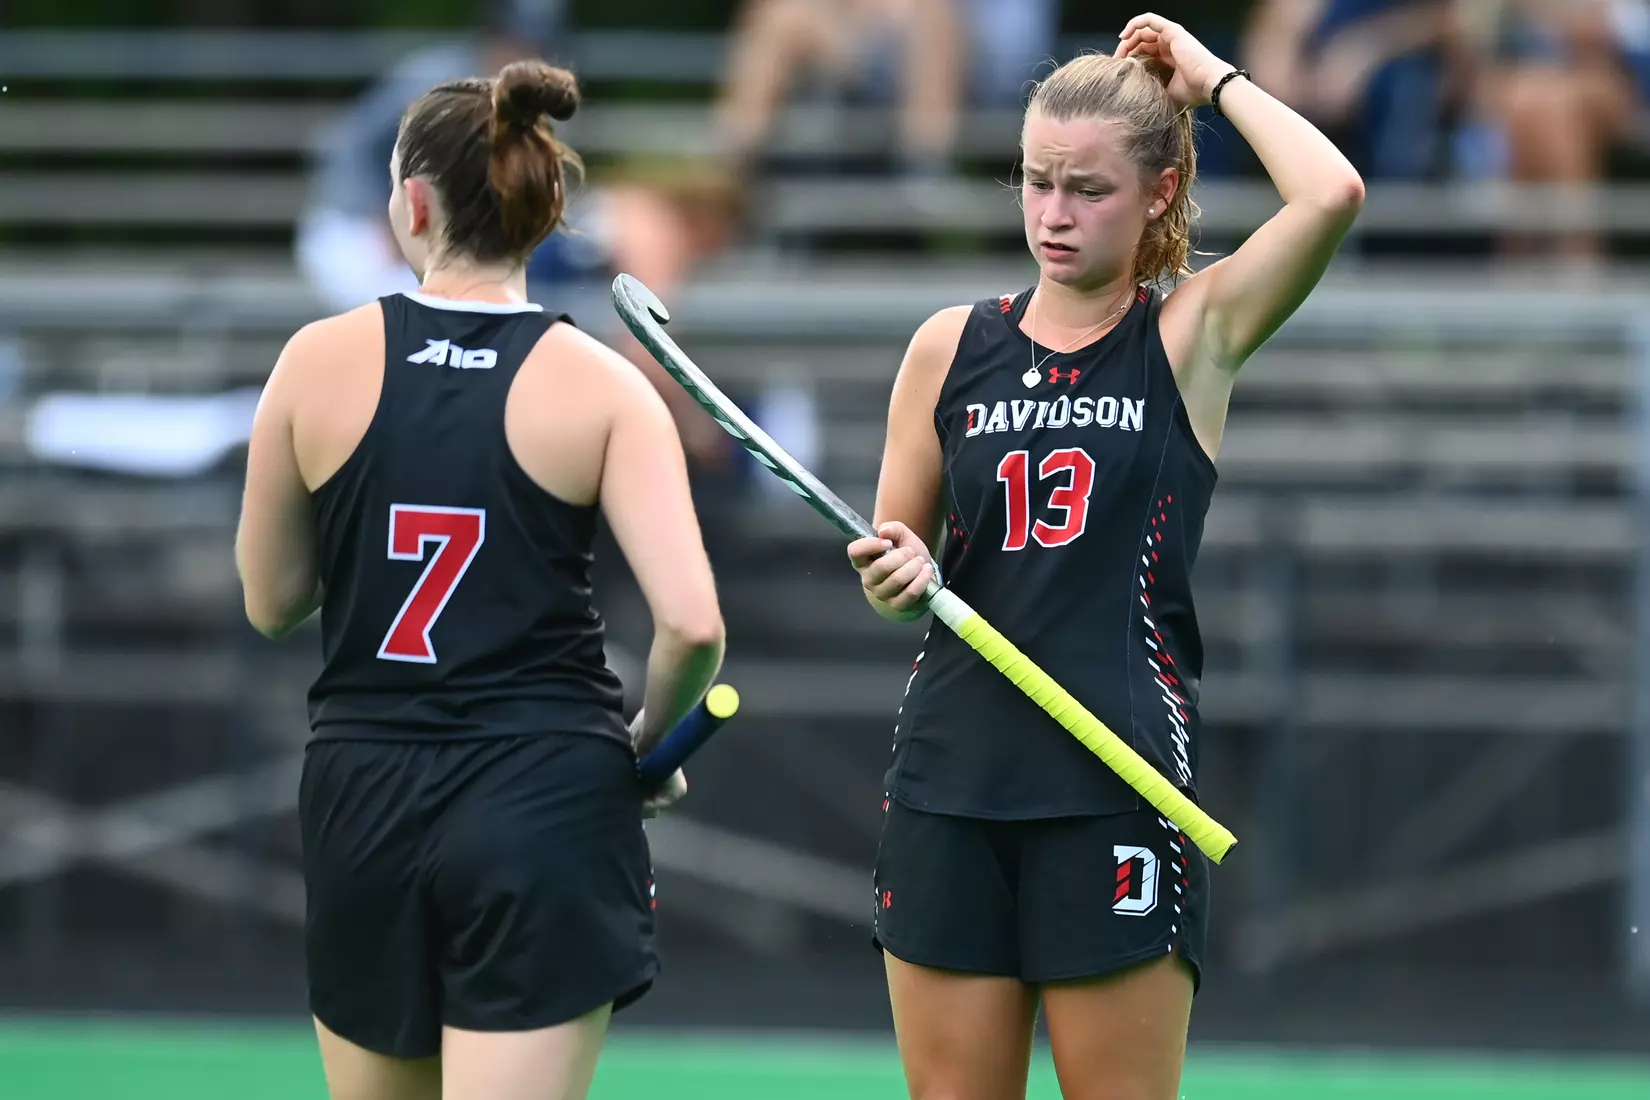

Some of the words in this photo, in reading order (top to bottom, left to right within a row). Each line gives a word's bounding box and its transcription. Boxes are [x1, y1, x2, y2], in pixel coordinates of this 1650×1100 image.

[406, 338, 498, 370] A10
[965, 394, 1146, 438] DAVIDSON
[996, 446, 1096, 552] 13
[376, 503, 487, 664] 7
[1111, 844, 1161, 917] D
